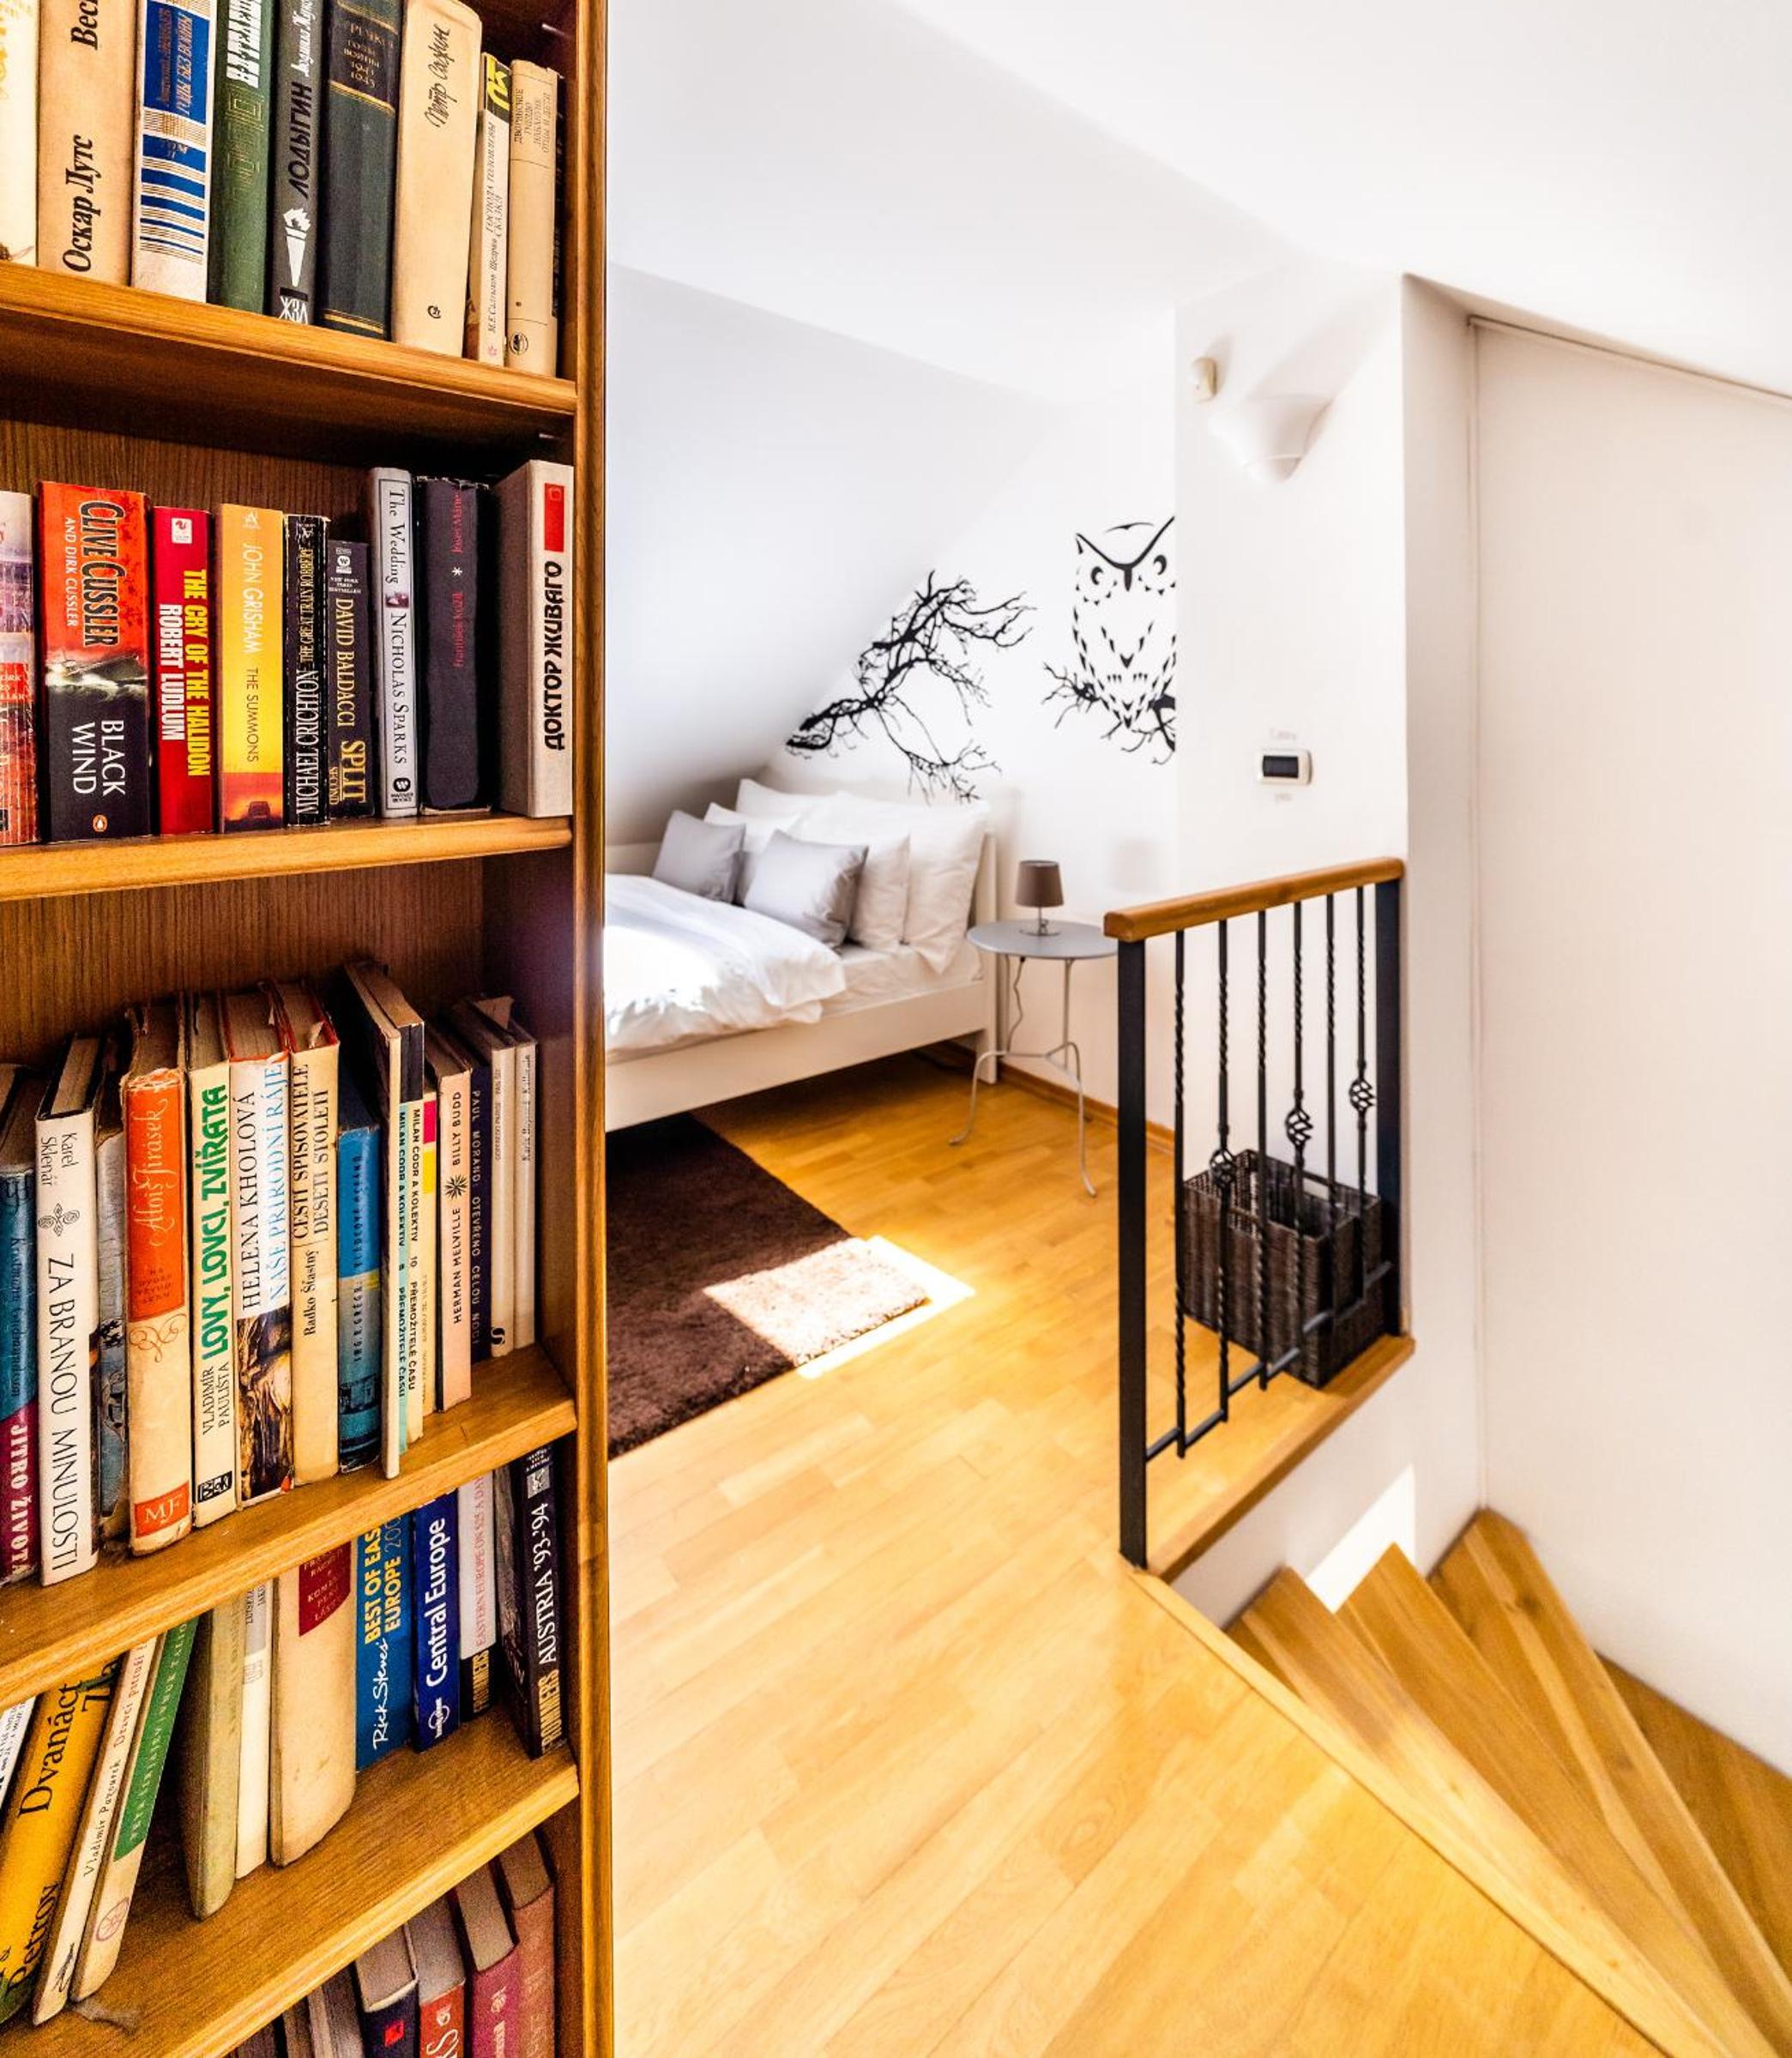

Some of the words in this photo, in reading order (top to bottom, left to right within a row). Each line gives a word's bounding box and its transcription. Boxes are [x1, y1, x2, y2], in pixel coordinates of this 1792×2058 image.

[70, 0, 98, 51] Вес
[176, 57, 191, 81] БЕЗ
[65, 135, 102, 195] Лутс
[287, 81, 312, 200] ЛОДЫГИН
[63, 196, 101, 273] Оскар
[485, 184, 496, 234] ГОСПОДА
[493, 194, 503, 238] СКАЗКИ
[279, 294, 308, 326] ЖЗЛ
[65, 517, 76, 544] AND
[79, 501, 124, 562] CLIVE
[389, 489, 405, 517] The
[65, 547, 77, 574] DIRK
[184, 569, 206, 600] THE
[243, 541, 263, 585] JOHN
[385, 524, 406, 585] Wedding
[65, 576, 79, 627] CUSSLER
[81, 562, 126, 647] CUSSLER
[185, 602, 208, 636] CRY
[243, 587, 264, 654] GRISHAM
[299, 588, 315, 615] TRAIN
[299, 617, 315, 644] GREAT
[335, 598, 353, 646] DAVID
[544, 561, 564, 658] ЖИВАГО
[160, 604, 183, 668] ROBERT
[186, 643, 208, 665] OF
[299, 645, 315, 663] THE
[390, 613, 407, 699] NICHOLAS
[160, 673, 185, 741] LUDLUM
[186, 667, 209, 699] THE
[246, 667, 258, 693] THE
[295, 669, 319, 745] CRICHTON
[335, 649, 354, 727] BALDACCI
[544, 660, 564, 751] ДОКТОР
[72, 722, 96, 794] WIND
[101, 720, 125, 796] BLACK
[187, 703, 211, 776] HALIDON
[246, 694, 259, 762] SUMMONS
[393, 703, 407, 764] SPARKS
[295, 747, 320, 815] MICHAEL
[341, 739, 367, 803] SPLIT
[260, 1064, 288, 1117] RÁJE
[452, 1091, 462, 1127] BUDD
[471, 1090, 480, 1122] PAUL
[62, 1132, 79, 1168] Karel
[133, 1098, 175, 1188] Jirásek
[195, 1084, 228, 1201] ZVÍŘATA
[232, 1091, 257, 1210] KHOLOVÁ
[412, 1145, 421, 1178] CODR
[452, 1132, 462, 1166] BILLY
[133, 1180, 175, 1247] Alois
[313, 1170, 329, 1234] DESETI
[410, 1191, 419, 1242] KOLEKTIV
[471, 1196, 482, 1257] OTEVŘENO
[202, 1200, 230, 1285] LOVCI,
[241, 1215, 261, 1311] HELENA
[410, 1256, 418, 1268] 10
[452, 1207, 462, 1267] MELVILLE
[48, 1253, 75, 1294] ZA
[266, 1240, 287, 1301] NAŠE
[452, 1270, 462, 1325] HERMAN
[471, 1264, 481, 1305] CELOU
[202, 1286, 232, 1360] LOVY,
[304, 1297, 316, 1336] Radko
[49, 1300, 78, 1415] BRANOU
[202, 1366, 214, 1434] VLADIMÍR
[217, 1361, 230, 1428] PAULIŠTA
[10, 1424, 28, 1489] JITRO
[51, 1427, 79, 1571] MINULOSTI
[10, 1499, 33, 1572] ŽIVOTA
[364, 1528, 382, 1568] EAS
[425, 1518, 450, 1600] Europe
[364, 1569, 382, 1596] OF
[384, 1556, 401, 1633] EUROPE
[473, 1548, 486, 1594] EUROPE
[364, 1602, 381, 1645] BEST
[425, 1604, 447, 1687] Central
[473, 1595, 487, 1646] EASTERN
[535, 1570, 556, 1666] AUSTRIA
[19, 1681, 81, 1819] Dvanáct
[372, 1705, 389, 1750] Rick
[4, 1880, 61, 2001] Petrov
